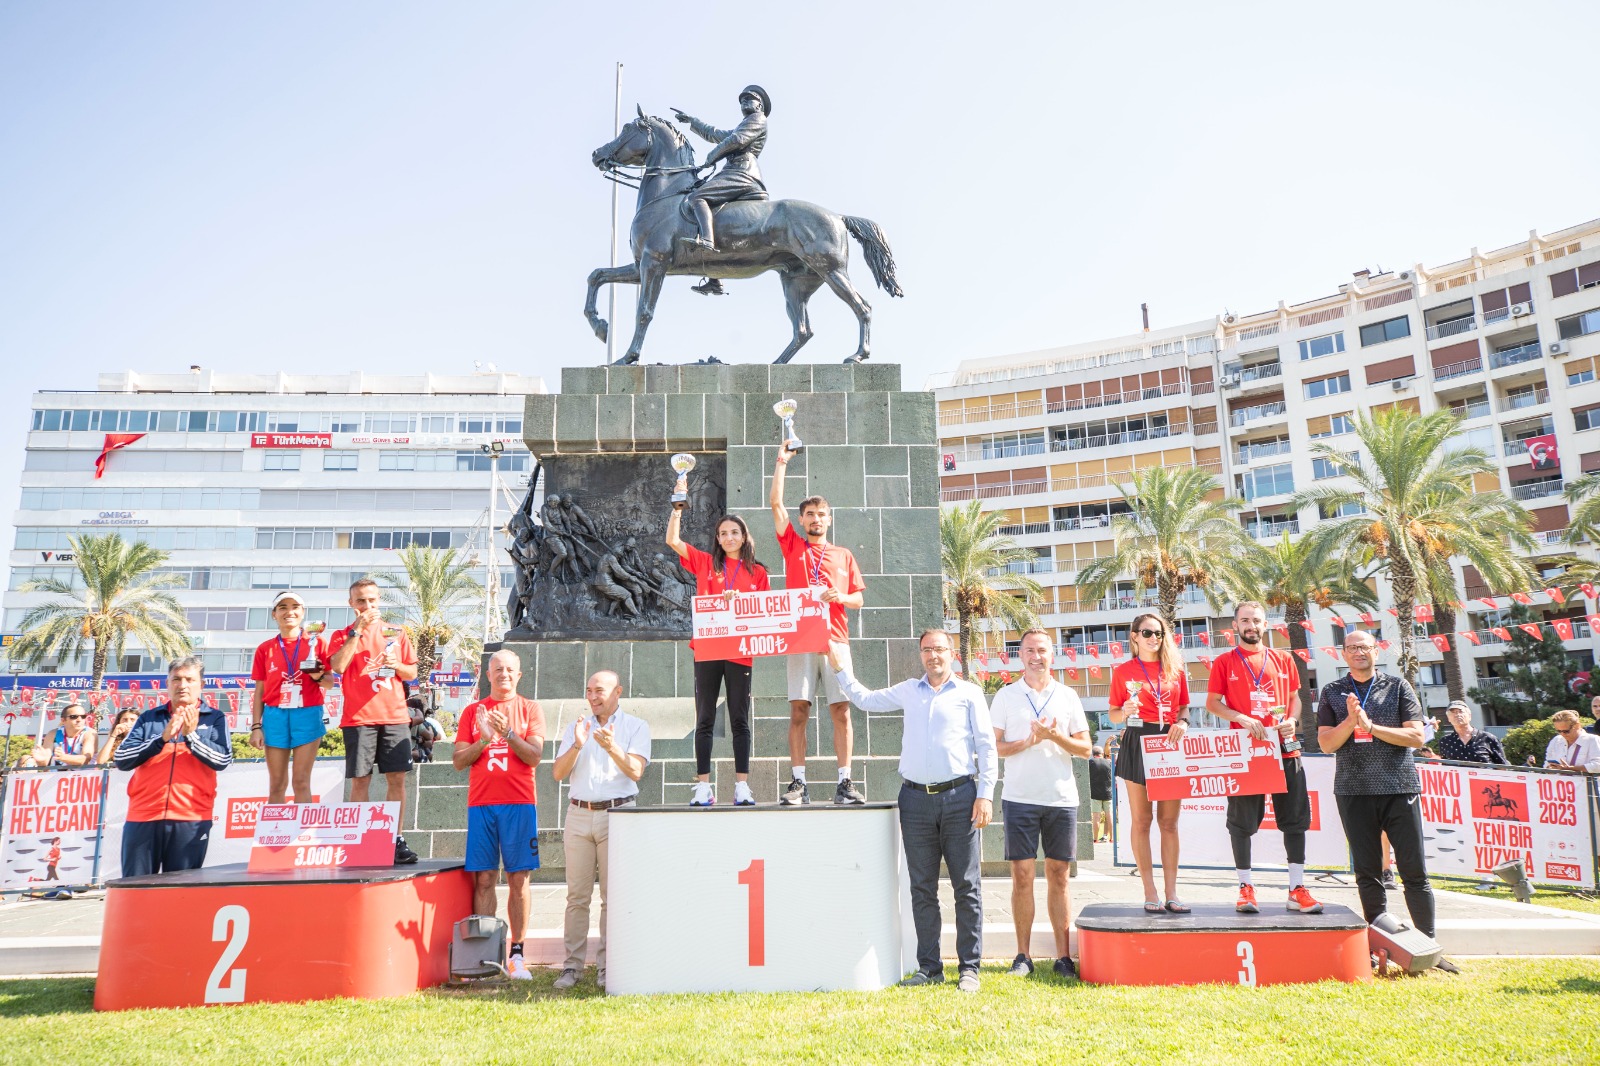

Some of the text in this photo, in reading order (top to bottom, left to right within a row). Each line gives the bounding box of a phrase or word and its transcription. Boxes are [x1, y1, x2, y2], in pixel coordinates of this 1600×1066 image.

[272, 434, 330, 446] TürkMedya
[98, 511, 133, 519] OMEGA
[734, 592, 791, 617] ÖDÜL ÇEKİ
[697, 626, 729, 637] 10.09.2023
[1182, 731, 1241, 757] ÖDÜL ÇEKİ
[1149, 766, 1180, 777] 10.09.2023
[13, 777, 43, 807] İLK
[1536, 778, 1576, 803] 10.09
[301, 804, 361, 829] ÖDÜL ÇEKİ
[1539, 801, 1577, 827] 2023
[258, 835, 291, 845] 10.09.2023
[1473, 821, 1533, 849] YENİ BİR
[738, 858, 765, 967] 1
[204, 904, 251, 1004] 2
[1236, 940, 1257, 988] 3
